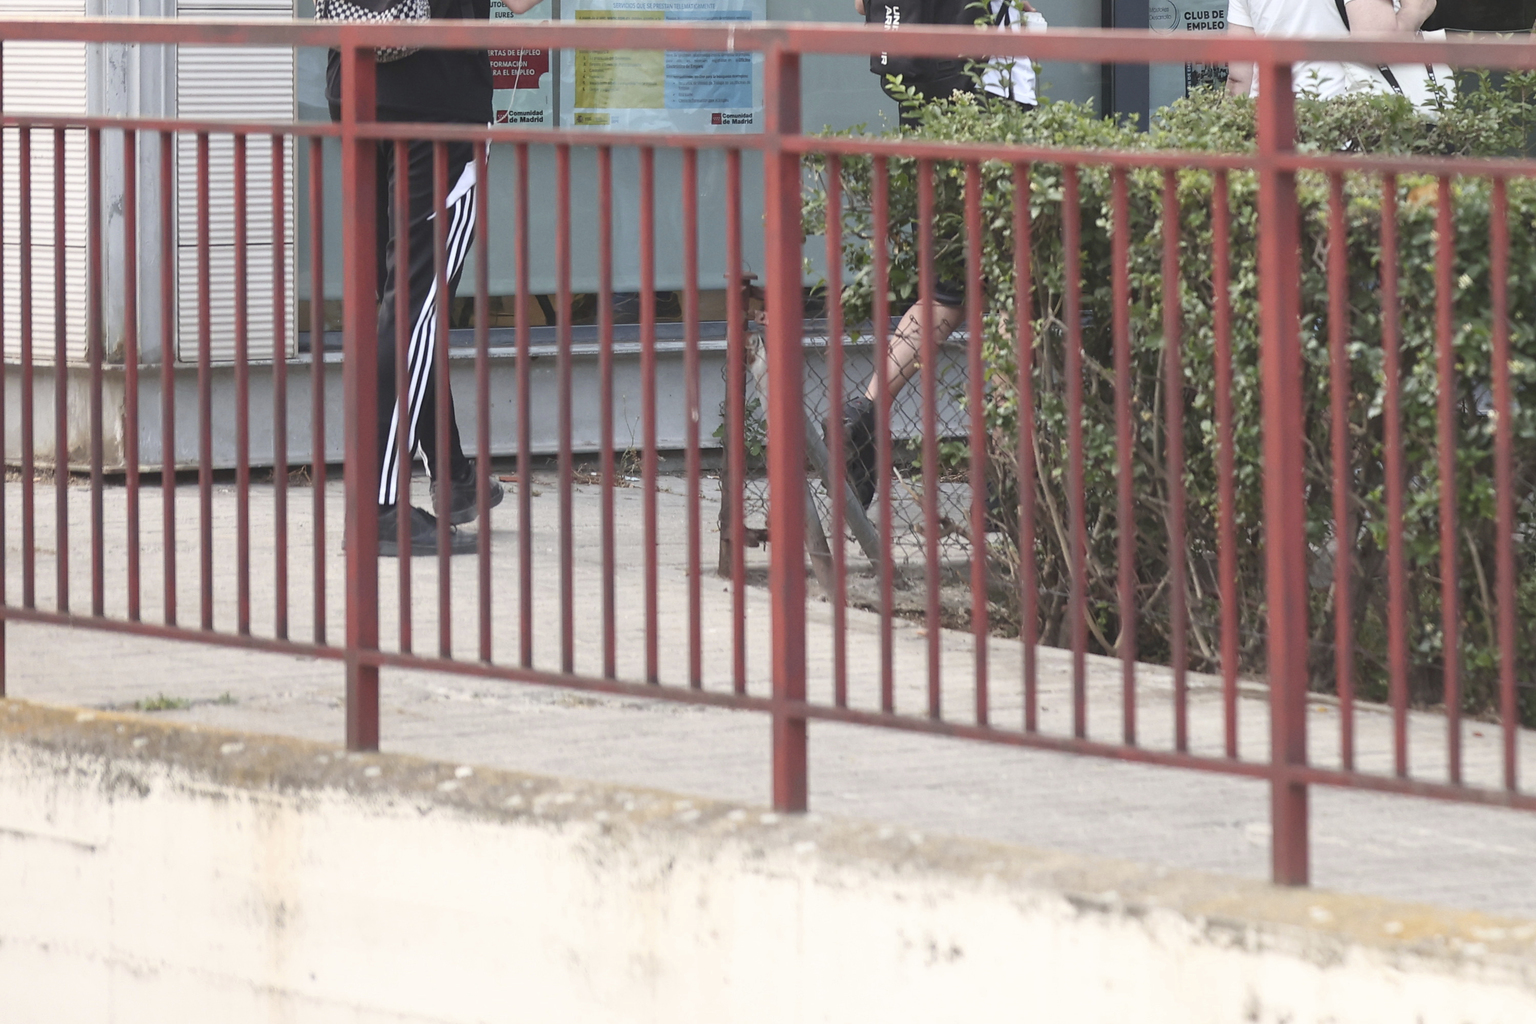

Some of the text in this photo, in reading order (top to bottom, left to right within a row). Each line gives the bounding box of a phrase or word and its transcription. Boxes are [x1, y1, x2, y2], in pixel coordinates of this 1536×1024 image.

[1184, 10, 1224, 20] CLUB DE
[1186, 21, 1225, 31] EMPLEO
